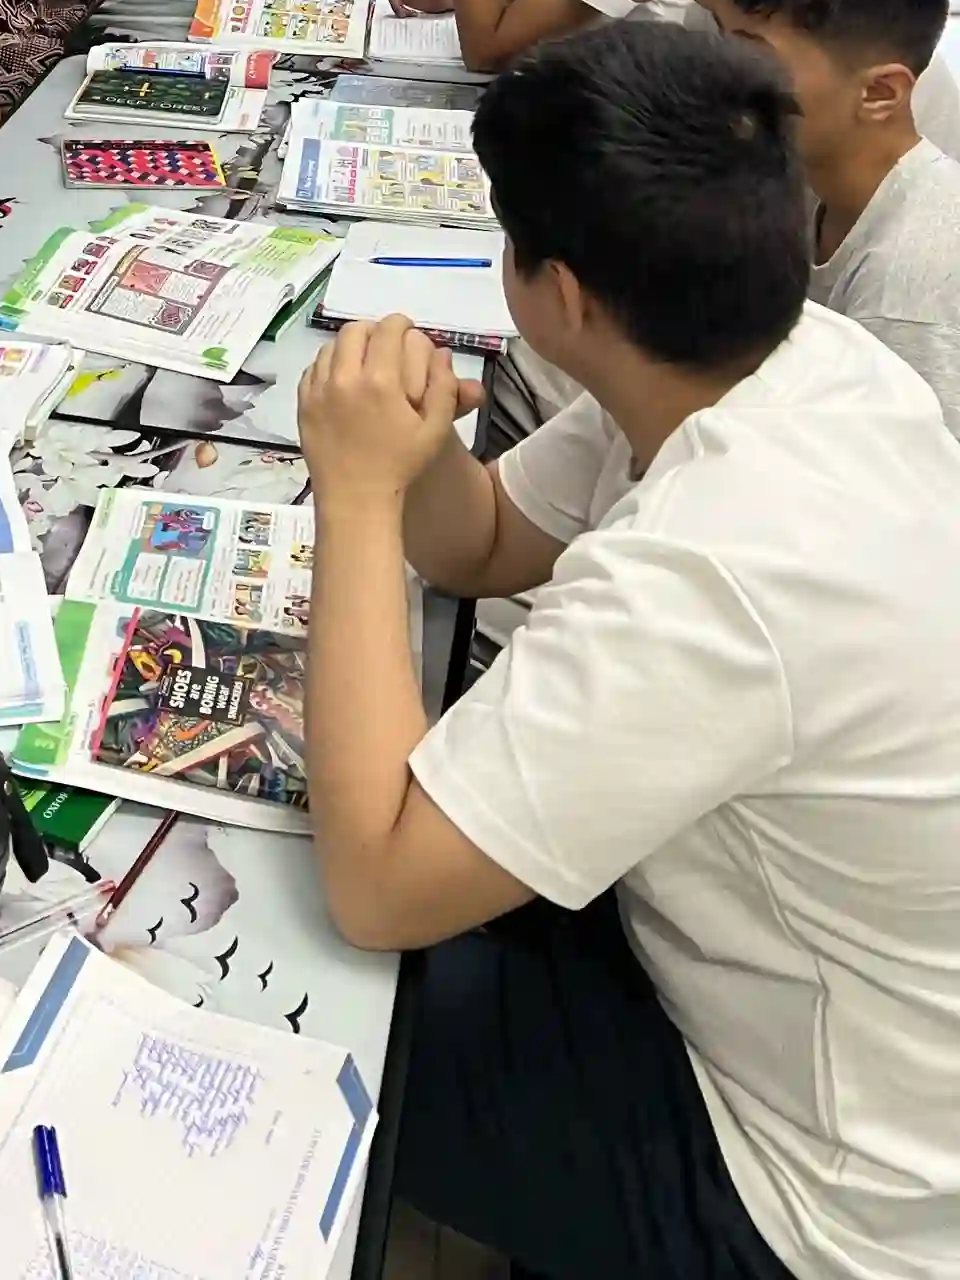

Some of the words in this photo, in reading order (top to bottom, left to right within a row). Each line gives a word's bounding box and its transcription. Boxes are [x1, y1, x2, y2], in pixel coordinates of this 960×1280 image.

[169, 669, 192, 710] SHOES
[188, 683, 201, 701] are
[198, 674, 221, 718] BORING
[215, 684, 230, 710] wear
